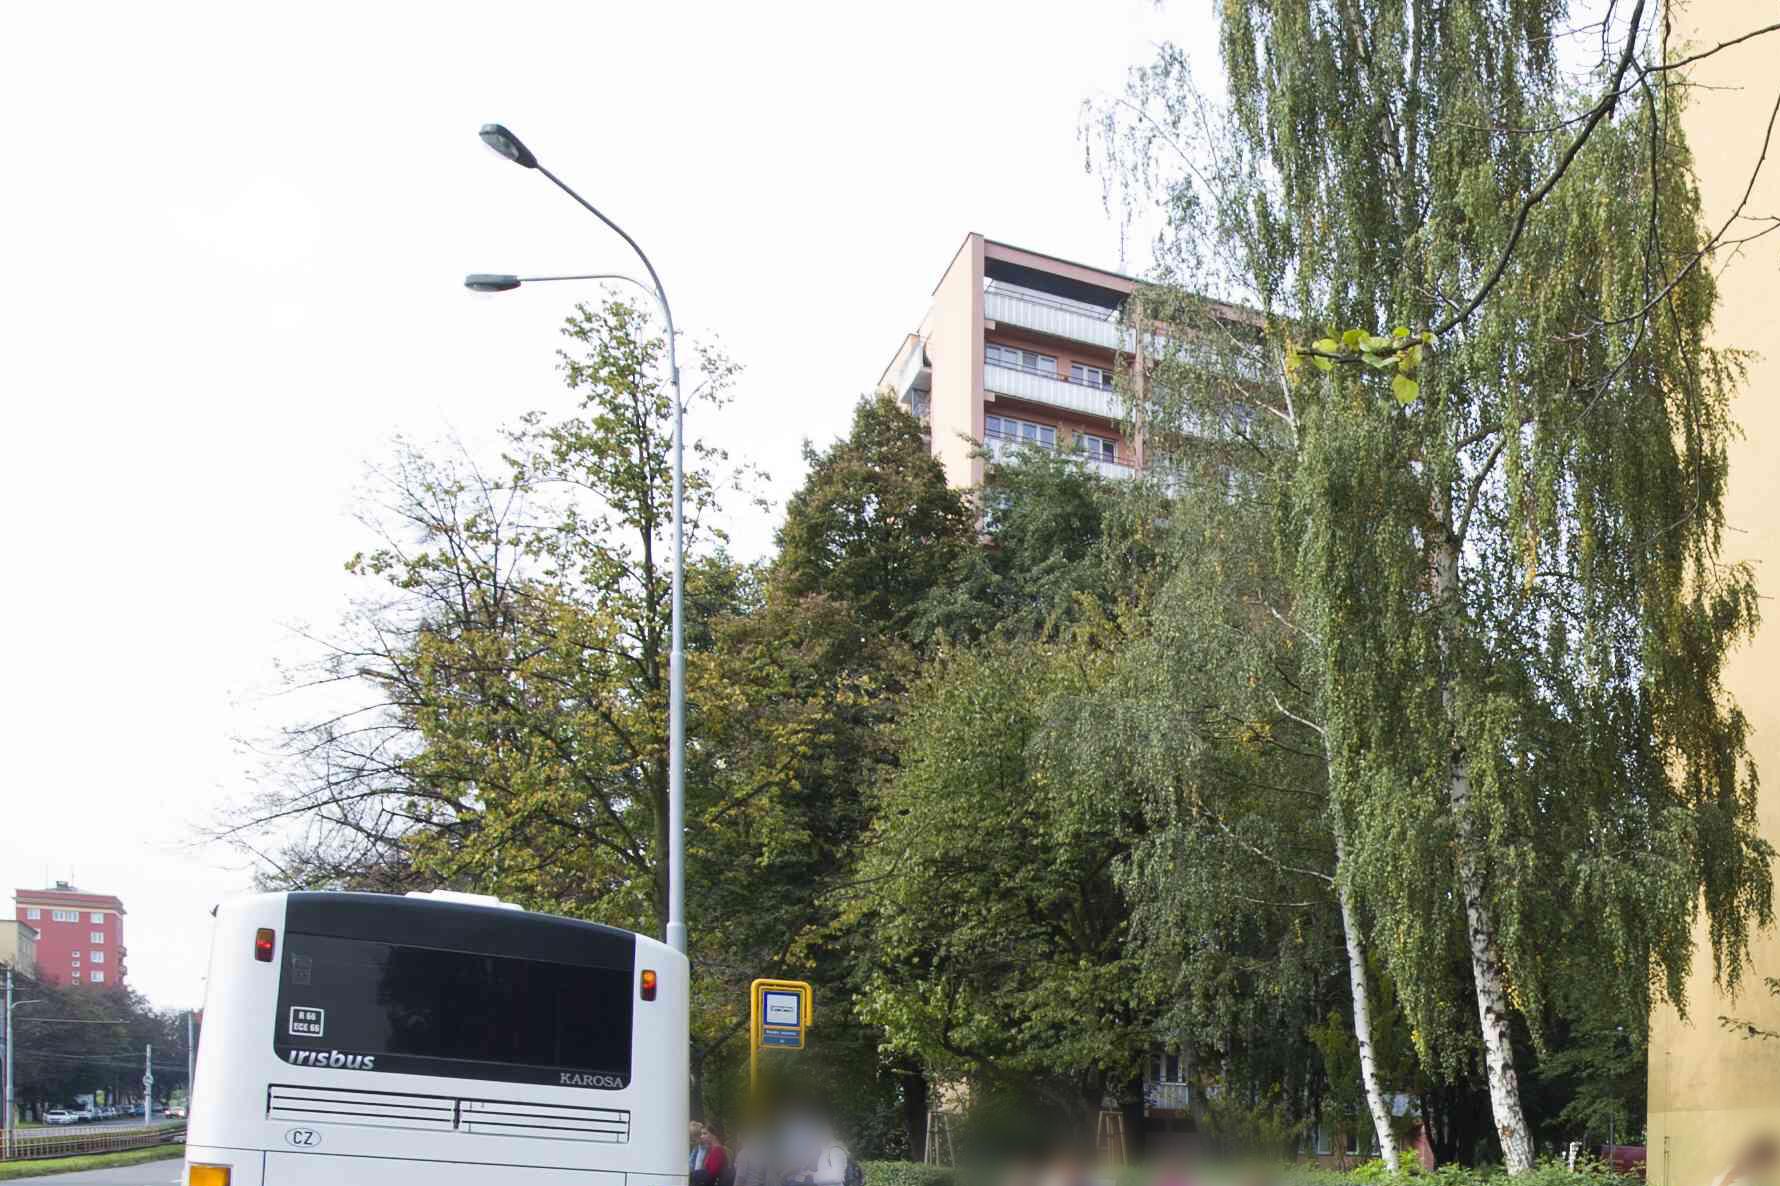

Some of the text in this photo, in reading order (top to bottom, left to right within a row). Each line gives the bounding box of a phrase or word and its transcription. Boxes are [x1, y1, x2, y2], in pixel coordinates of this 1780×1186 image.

[289, 1047, 375, 1071] irisbus
[560, 1072, 625, 1089] KAROSA
[293, 1130, 313, 1146] CZ
